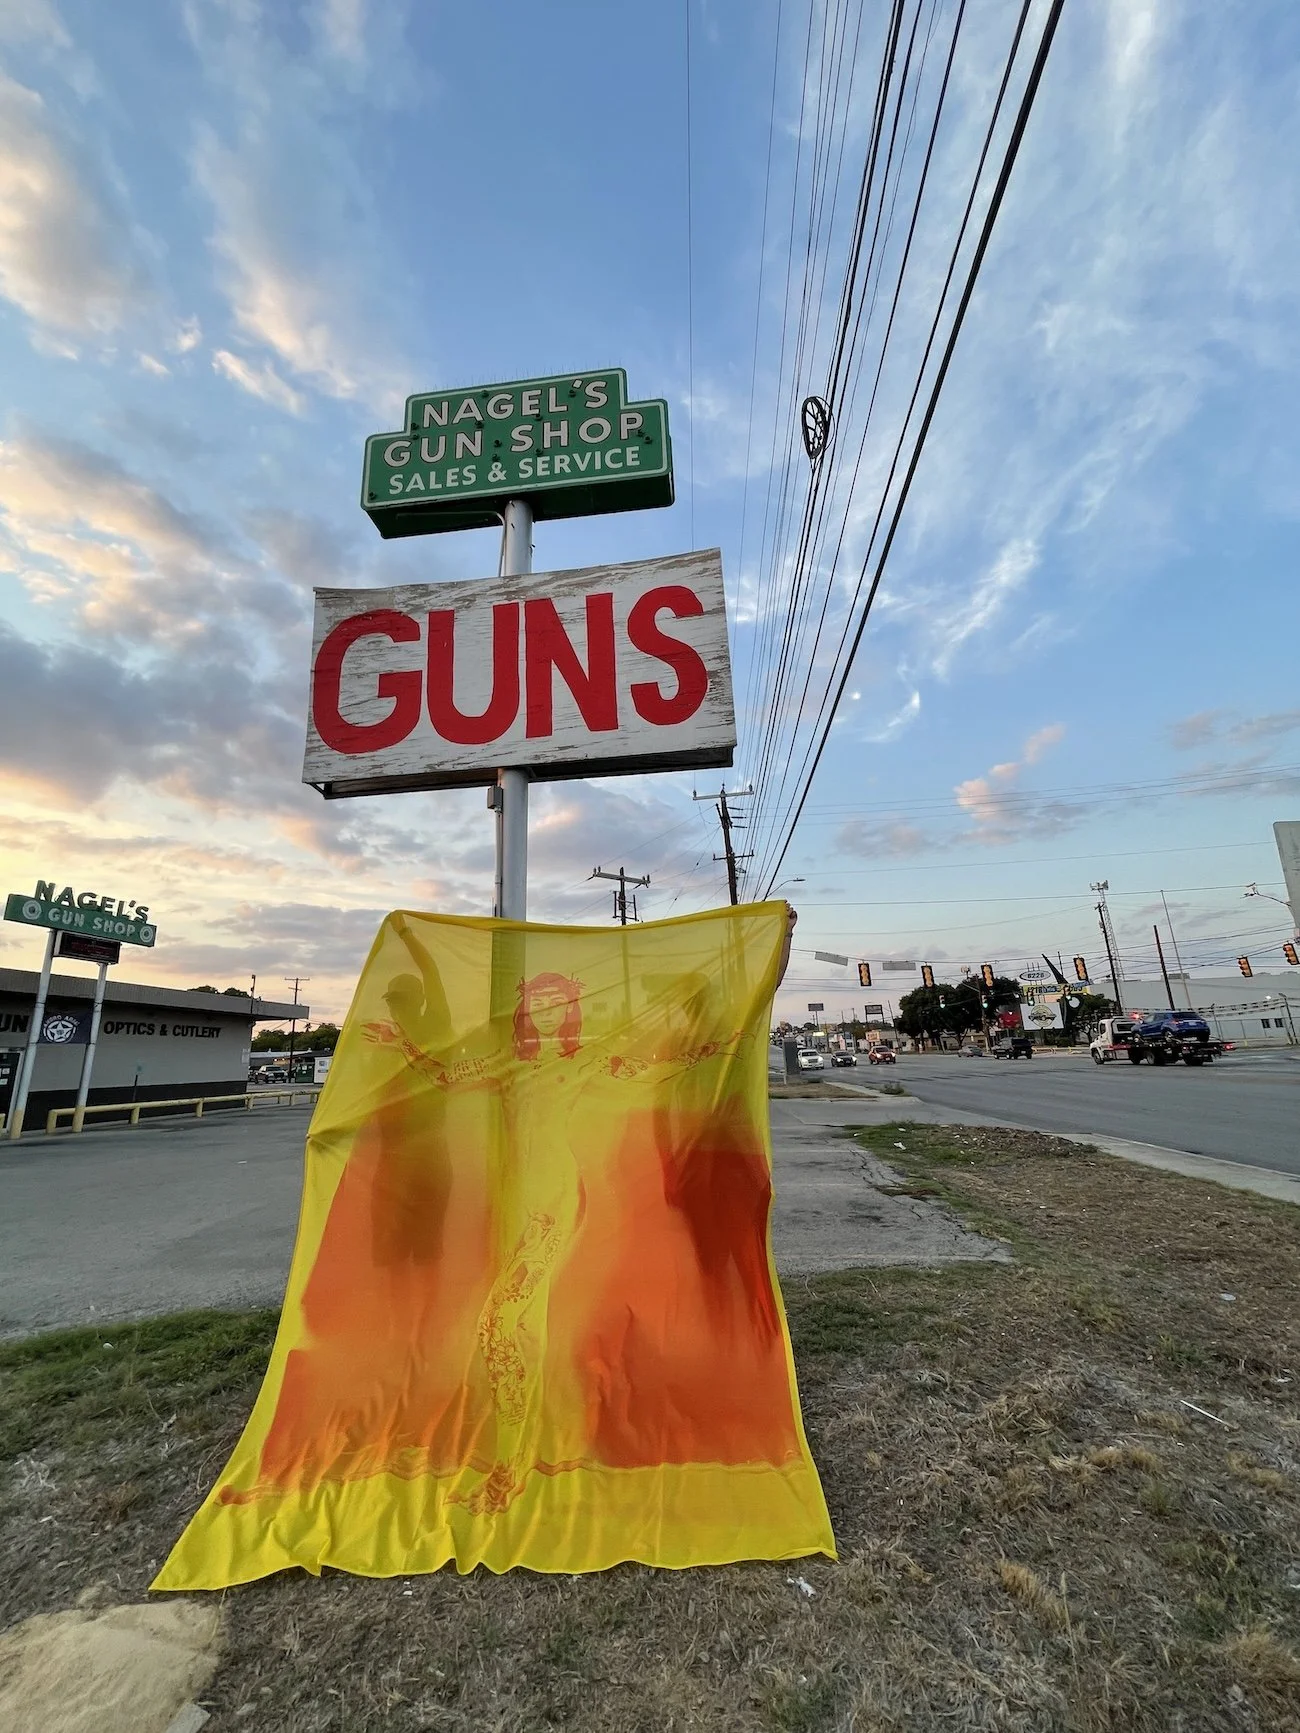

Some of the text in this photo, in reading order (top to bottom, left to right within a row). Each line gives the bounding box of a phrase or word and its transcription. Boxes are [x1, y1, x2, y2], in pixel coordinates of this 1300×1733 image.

[423, 379, 608, 428] NAGEL'S
[384, 412, 643, 467] GUN SHOP
[389, 446, 640, 495] SALES & SERVICE
[312, 585, 709, 754] GUNS
[34, 880, 149, 924] NAGEL'S
[48, 907, 136, 937] GUN SHOP
[103, 1021, 155, 1035] OPTICS
[160, 1024, 168, 1036] &
[172, 1025, 221, 1038] CUTLERY
